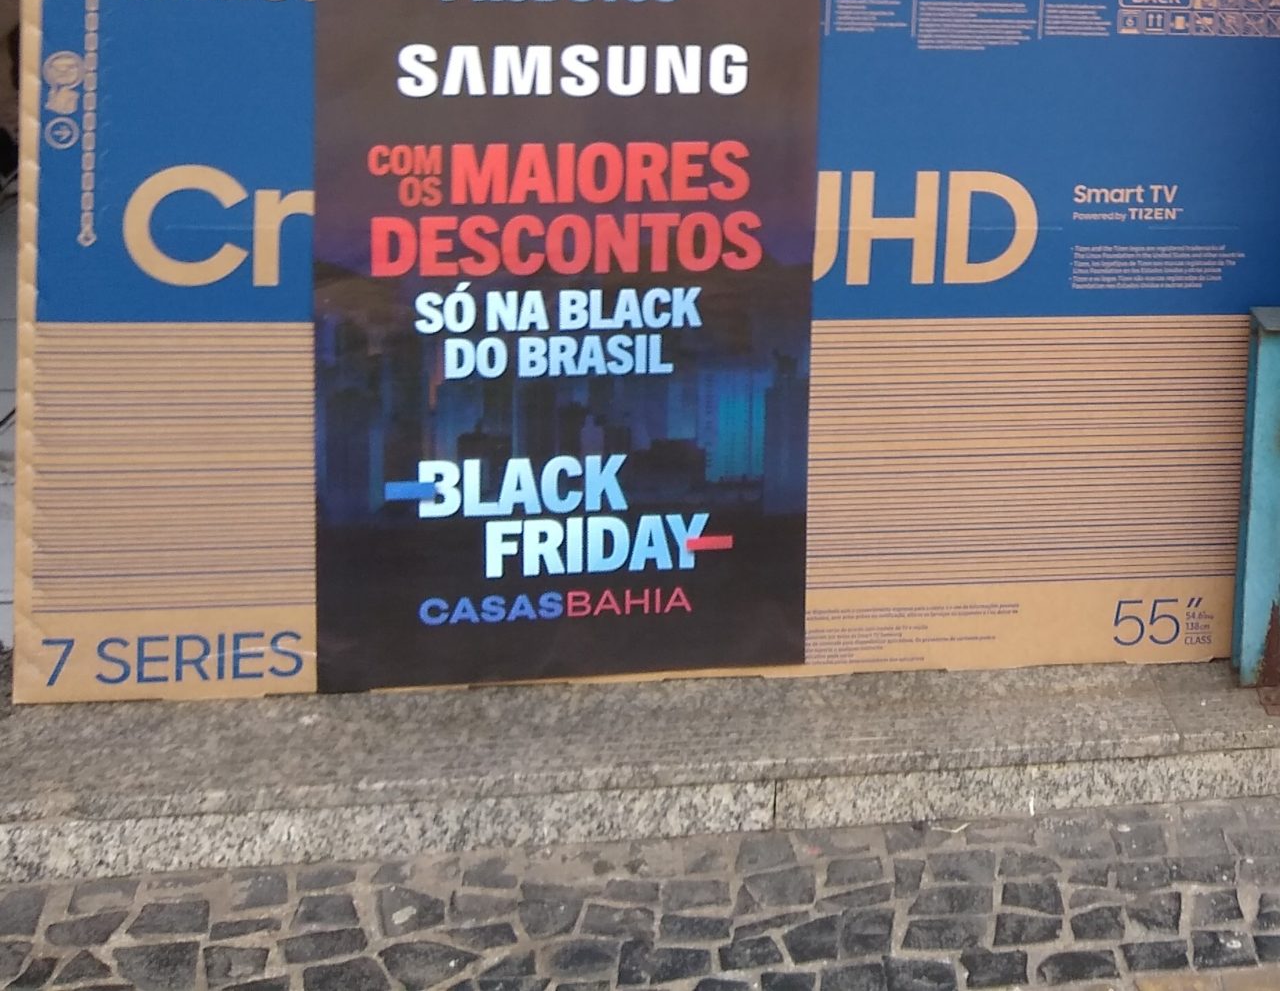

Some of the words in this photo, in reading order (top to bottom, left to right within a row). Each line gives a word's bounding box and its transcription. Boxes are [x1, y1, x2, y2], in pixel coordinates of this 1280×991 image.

[397, 43, 750, 98] SAMSUNG
[367, 143, 442, 177] COM
[450, 140, 751, 207] MAIORES
[398, 177, 442, 208] OS
[1073, 185, 1145, 204] Smart
[1149, 185, 1178, 204] TV
[1072, 212, 1113, 221] Powered
[1115, 212, 1126, 222] by
[370, 213, 763, 278] DESCONTOS
[414, 284, 475, 334] SÓ
[485, 290, 549, 332] NA
[557, 286, 702, 331] BLACK
[444, 337, 508, 379] DO
[516, 333, 673, 378] BRASIL
[417, 454, 628, 518] BLACK
[484, 512, 710, 578] FRIDAY
[41, 639, 75, 687] 7
[95, 630, 304, 686] SERIES
[1185, 635, 1212, 644] CLASS
